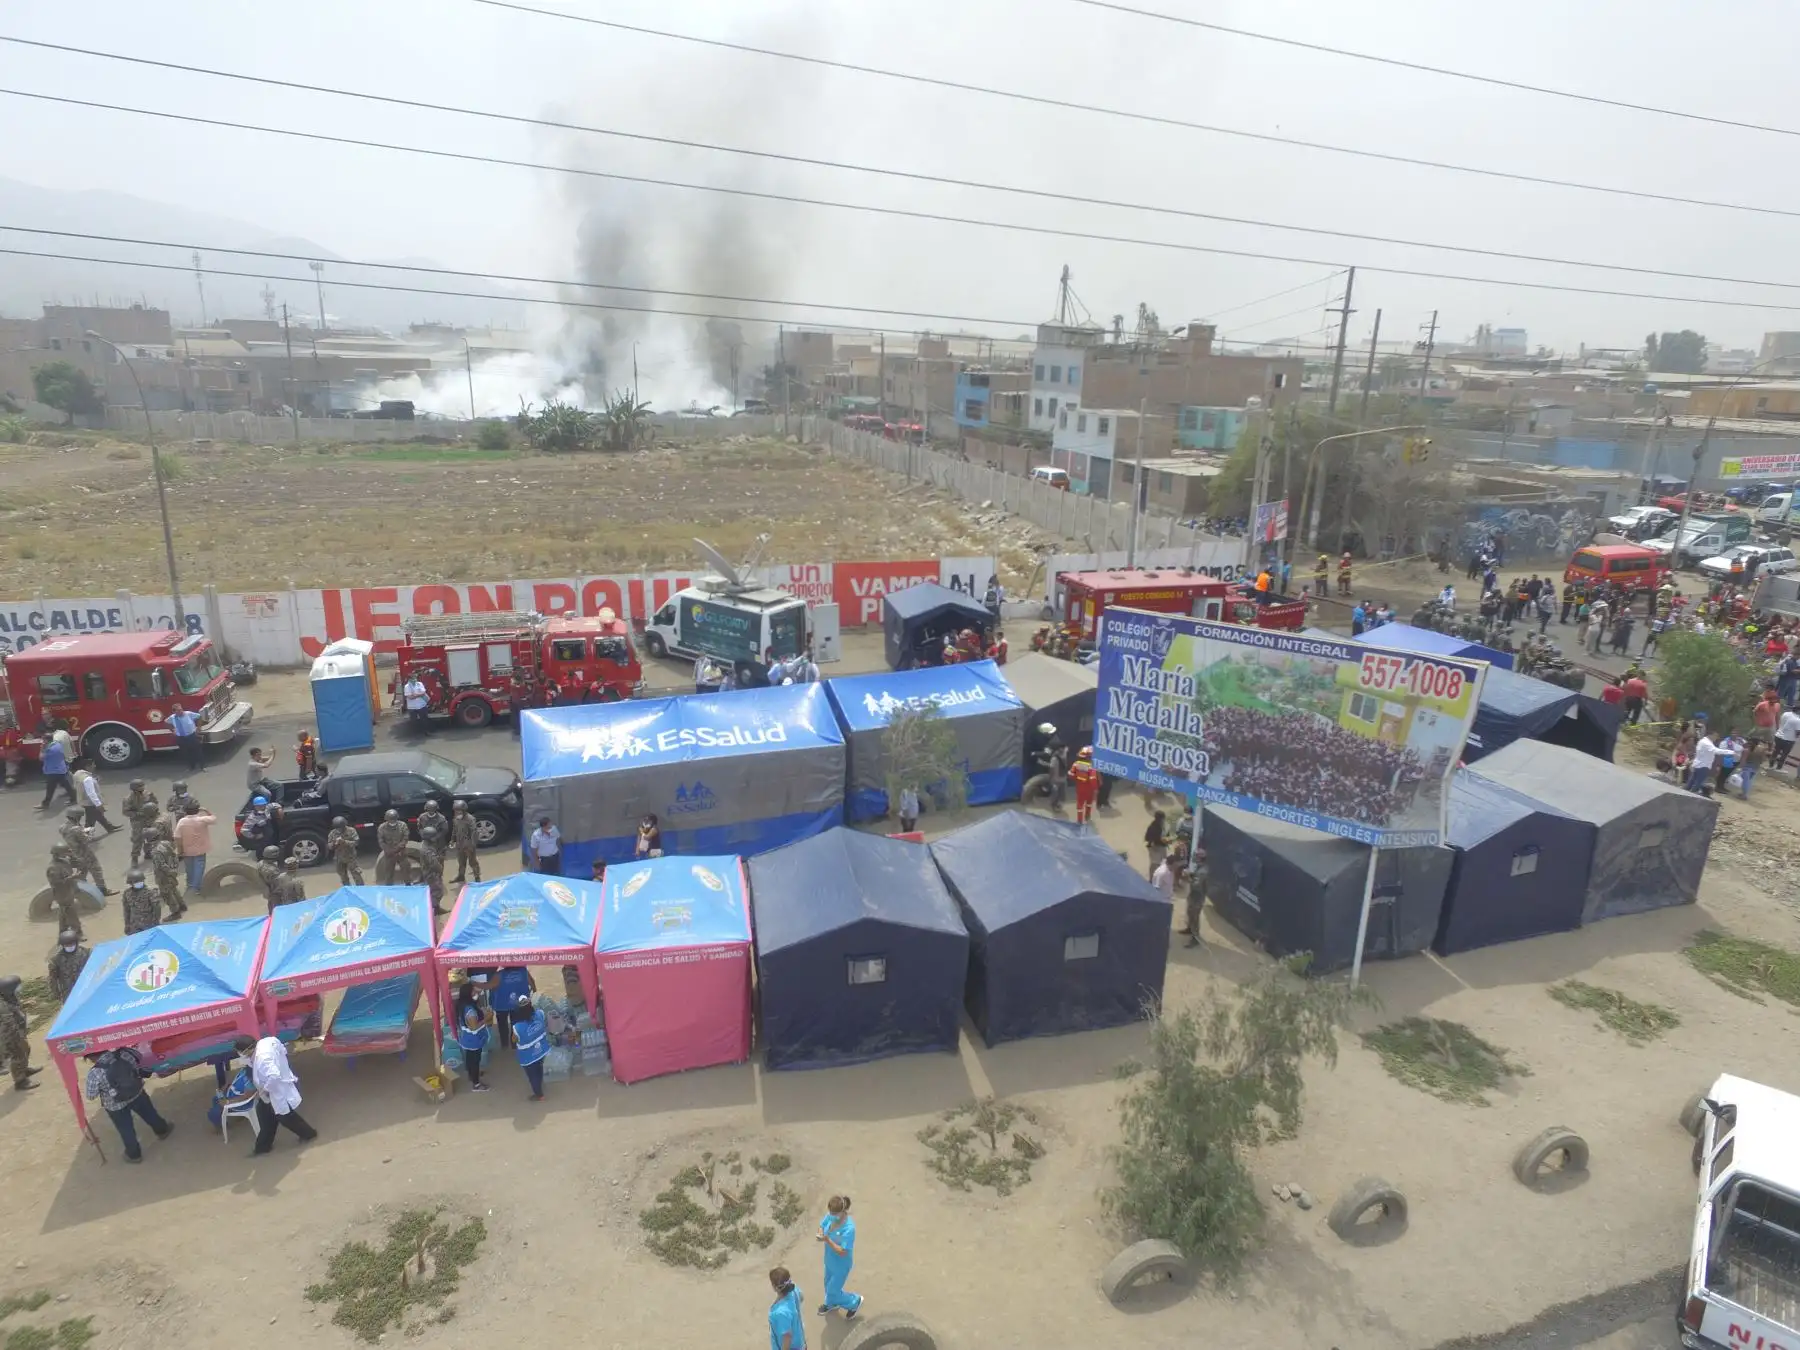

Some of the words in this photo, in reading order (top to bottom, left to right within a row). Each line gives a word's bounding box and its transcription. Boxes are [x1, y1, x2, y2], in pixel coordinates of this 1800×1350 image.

[0, 608, 123, 632] ALCALDE
[1108, 620, 1150, 637] COLEGIO
[1107, 635, 1149, 652] PRIVADO
[1194, 625, 1275, 648] FORMACIÓN
[1277, 638, 1351, 660] INTEGRAL
[1121, 654, 1195, 699] María
[1359, 652, 1464, 699] 557-1008
[1108, 687, 1204, 738] Medalla
[656, 722, 787, 751] EsSalud
[1097, 719, 1210, 775] Milagrosa
[1092, 758, 1128, 777] TEATRO
[1196, 787, 1239, 808] DANZAS
[1257, 802, 1318, 829] DEPORTES
[1374, 832, 1438, 846] INTENSIVO
[438, 954, 498, 964] SUBGERENCIA
[500, 954, 512, 963] DE
[513, 953, 541, 963] SALUD
[541, 953, 548, 961] Y
[549, 953, 585, 962] SANIDAD
[604, 958, 661, 971] SUBGERENCIA
[662, 954, 674, 965] DE
[674, 952, 701, 964] SALUD
[702, 952, 709, 961] Y
[709, 950, 745, 961] SANIDAD
